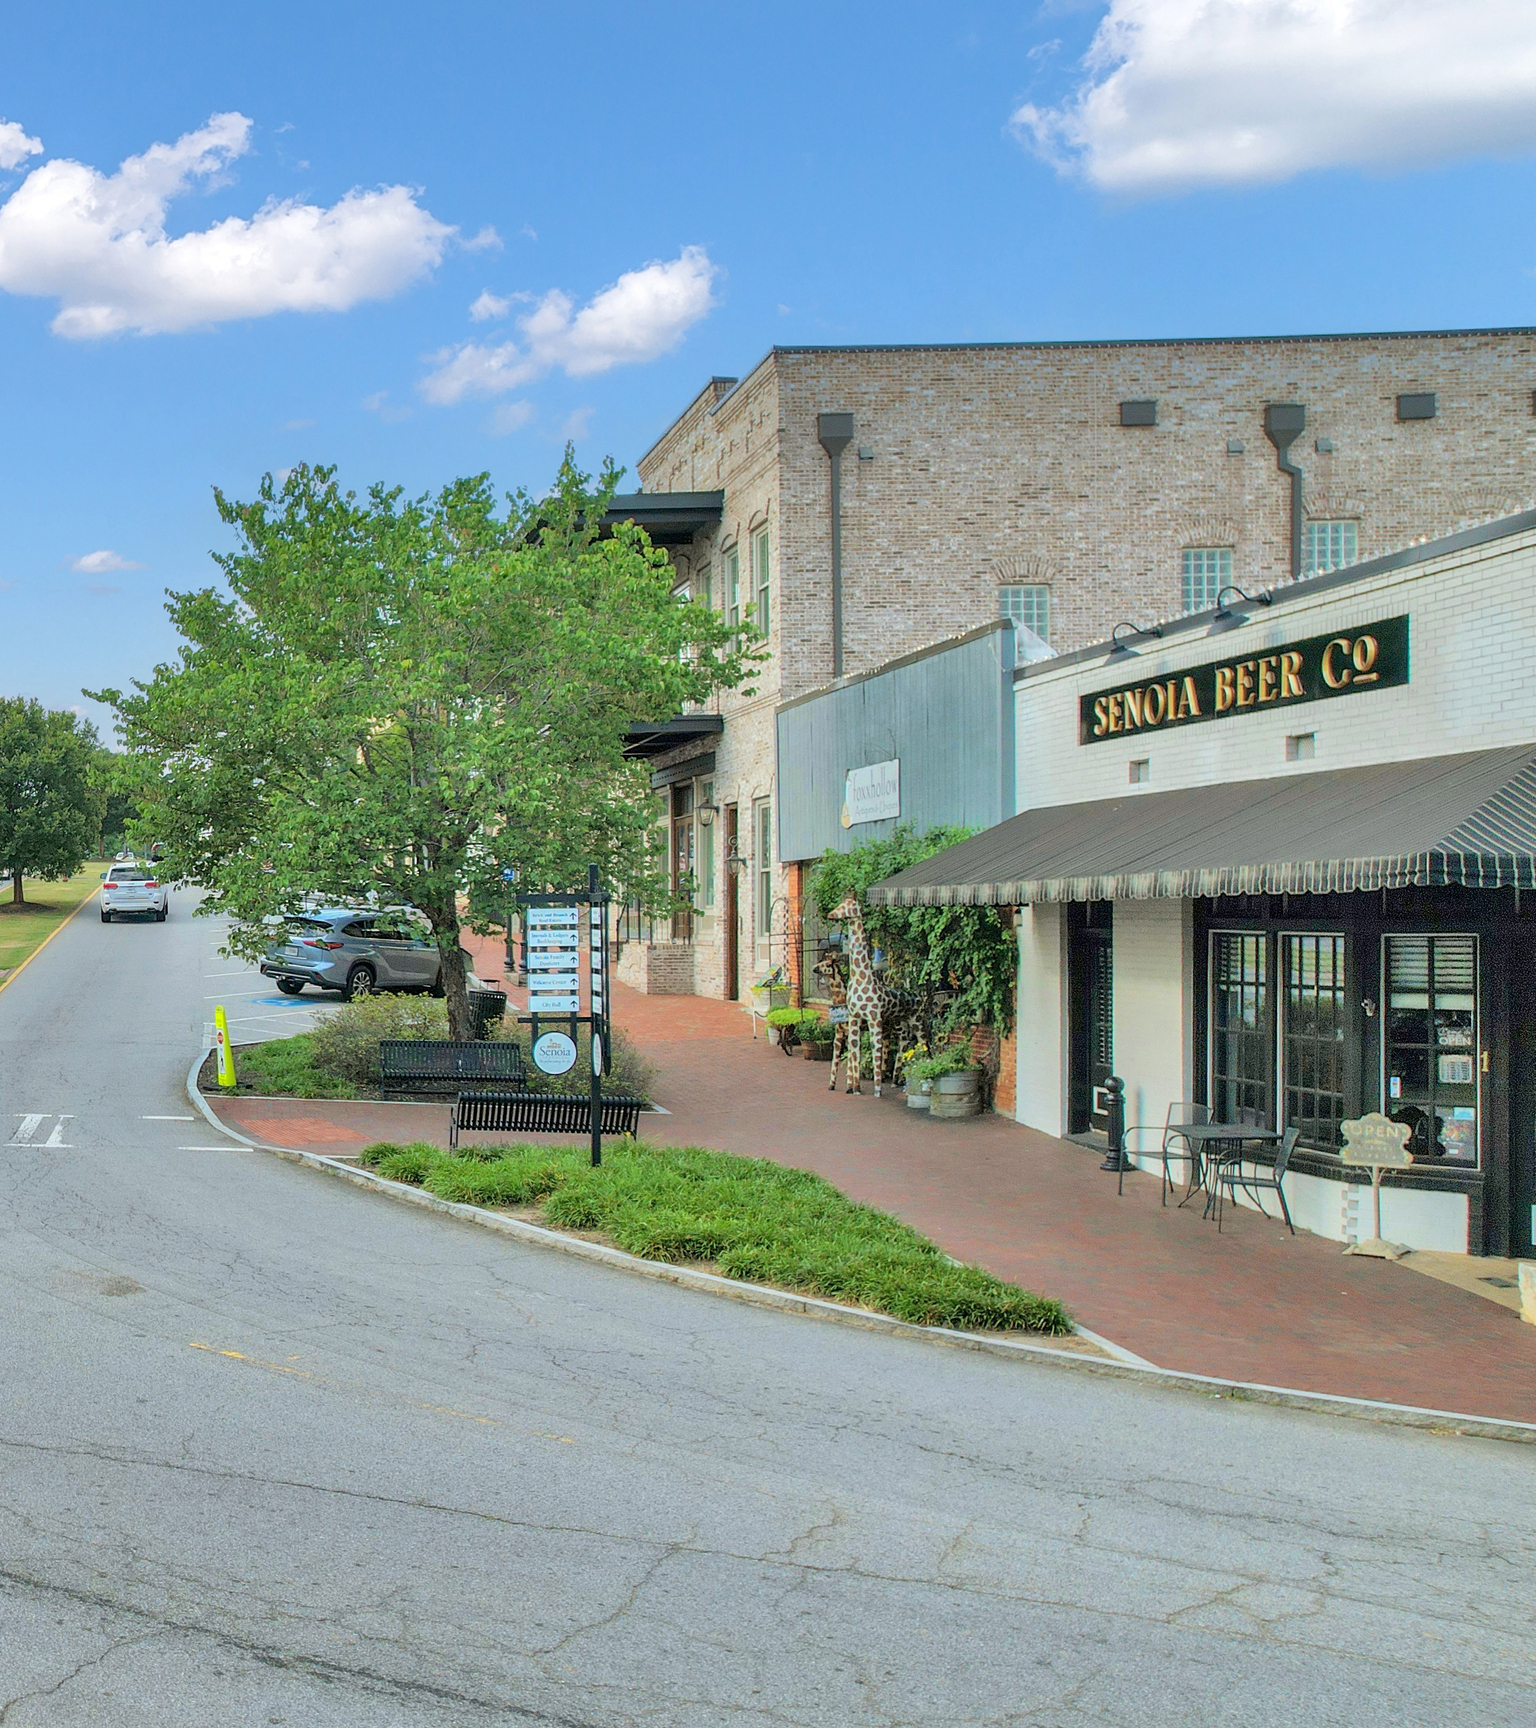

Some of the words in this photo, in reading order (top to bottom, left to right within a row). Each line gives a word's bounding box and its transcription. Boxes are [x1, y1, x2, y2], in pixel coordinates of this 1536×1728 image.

[1093, 675, 1202, 737] SENOIA
[1215, 650, 1307, 712] BEER
[1438, 1036, 1471, 1046] OPEN
[539, 1045, 571, 1057] Senoia
[1350, 1122, 1399, 1138] OPEN
